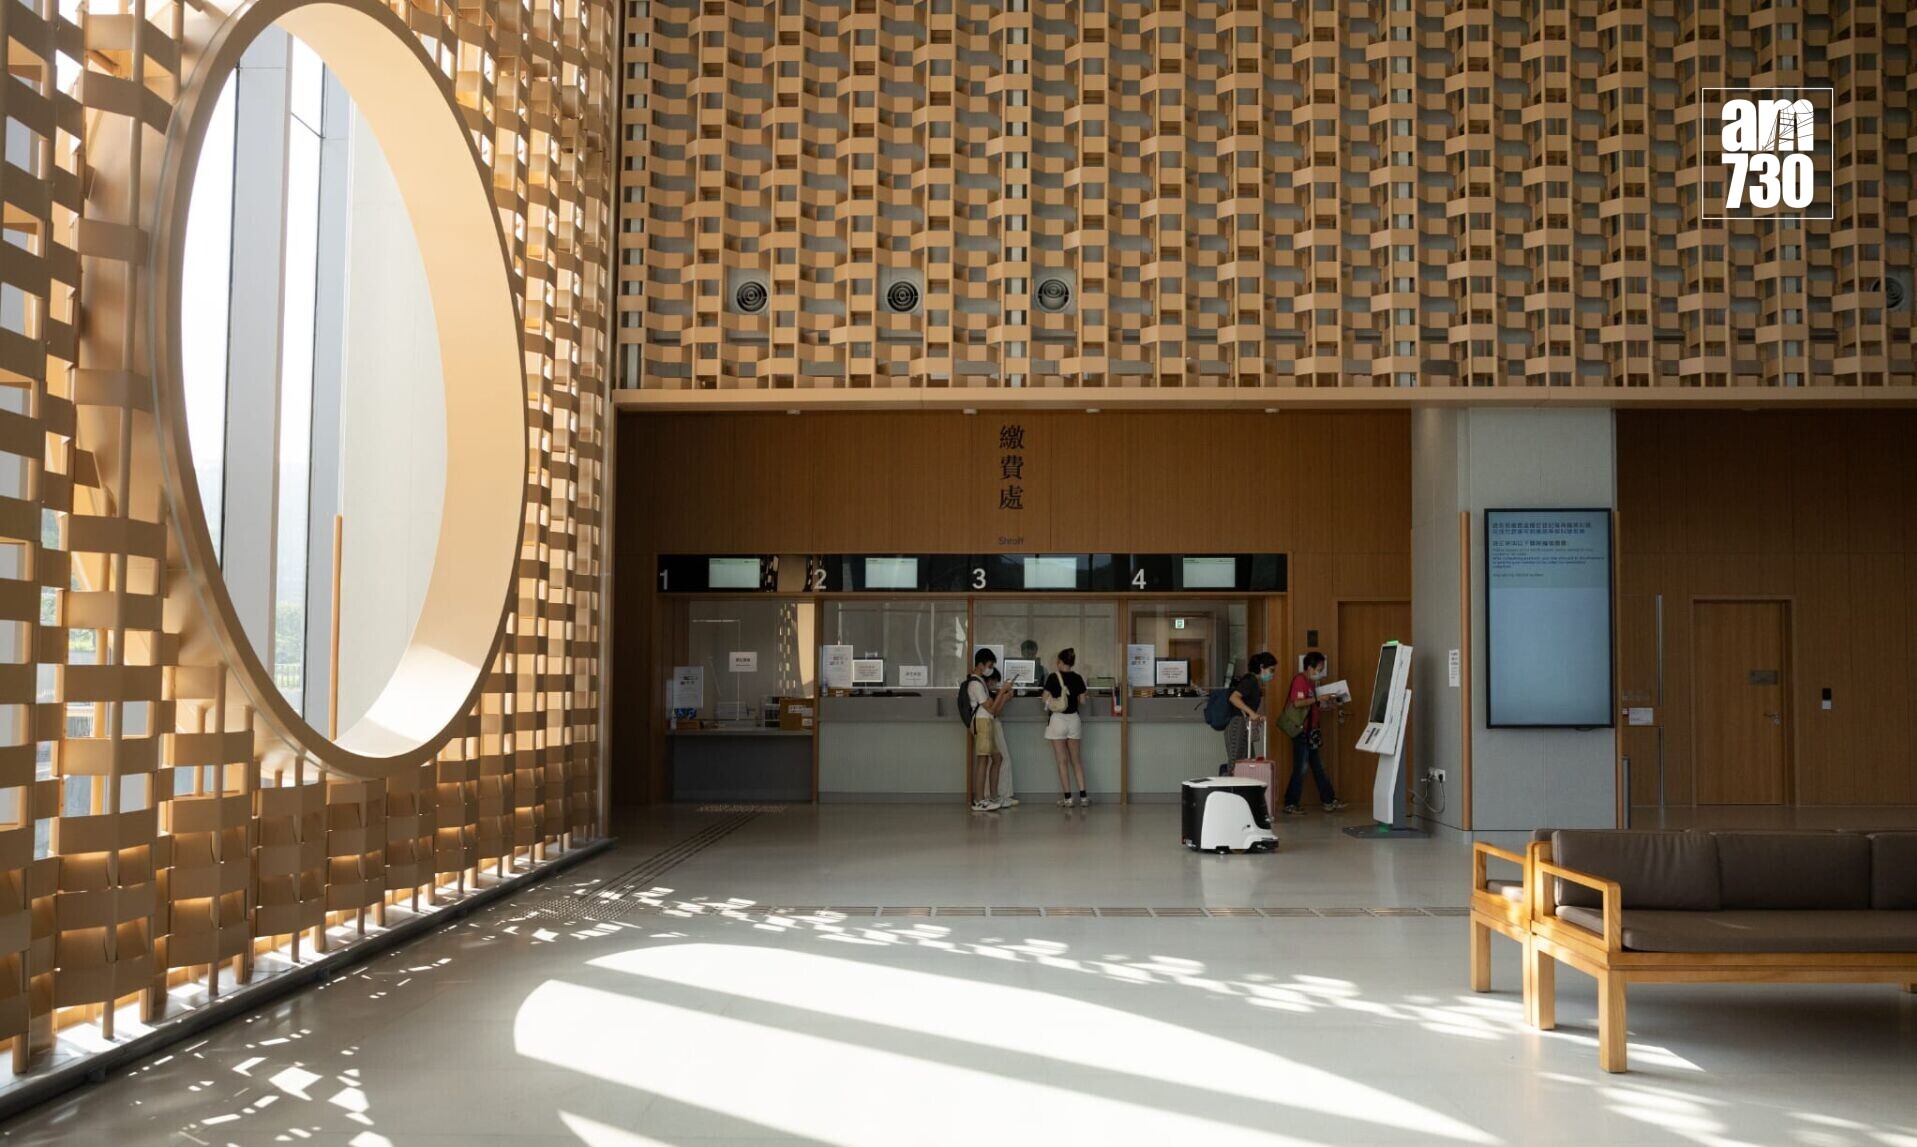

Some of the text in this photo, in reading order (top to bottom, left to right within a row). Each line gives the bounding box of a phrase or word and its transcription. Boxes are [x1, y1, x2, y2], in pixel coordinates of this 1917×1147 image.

[999, 424, 1026, 510] 繳費處
[659, 569, 669, 590] 1
[814, 568, 828, 590] 2
[972, 568, 987, 590] 3
[1131, 568, 1147, 590] 4
